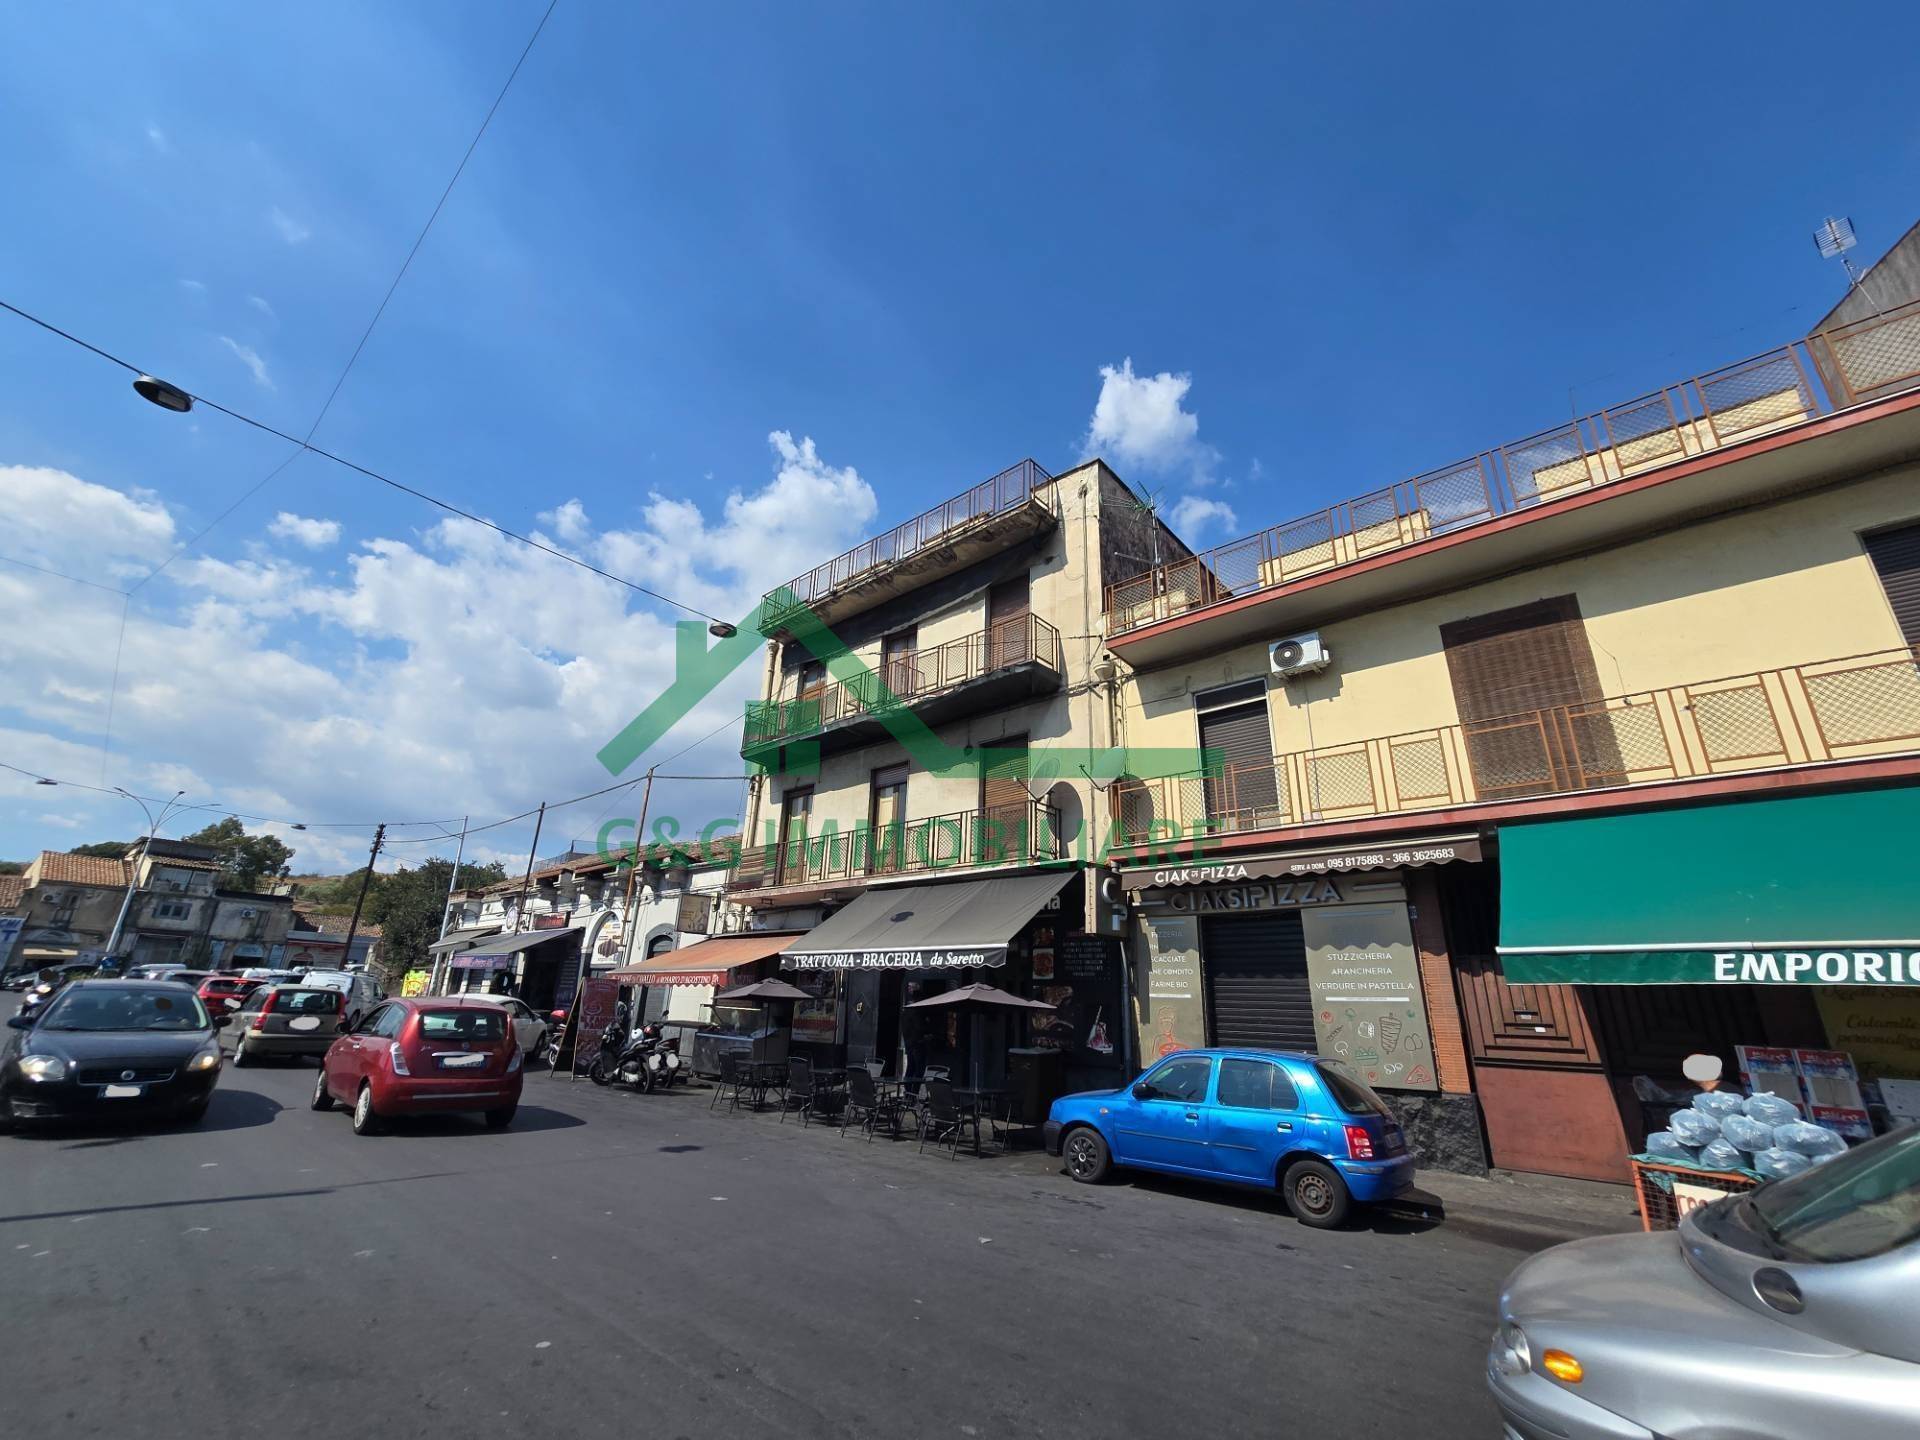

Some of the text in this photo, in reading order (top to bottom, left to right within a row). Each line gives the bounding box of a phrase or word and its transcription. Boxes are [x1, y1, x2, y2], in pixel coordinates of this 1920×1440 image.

[1327, 858, 1344, 869] 095
[1345, 854, 1384, 868] 8175883
[1392, 852, 1411, 863] 366
[1412, 848, 1455, 862] 3625683
[1154, 870, 1190, 884] CIAK
[1200, 864, 1248, 880] PIZZA
[793, 953, 855, 968] TRATTORIA
[862, 951, 923, 967] BRACERIA
[930, 954, 943, 966] da
[945, 951, 985, 966] Saretto
[1150, 955, 1186, 963] SCACCIATE
[1327, 952, 1393, 961] STUZZICHERIA
[1331, 966, 1393, 976] ARANCINERIA
[1713, 951, 1920, 982] EMPORI
[1315, 982, 1415, 991] VERDURE IN PASTELLA
